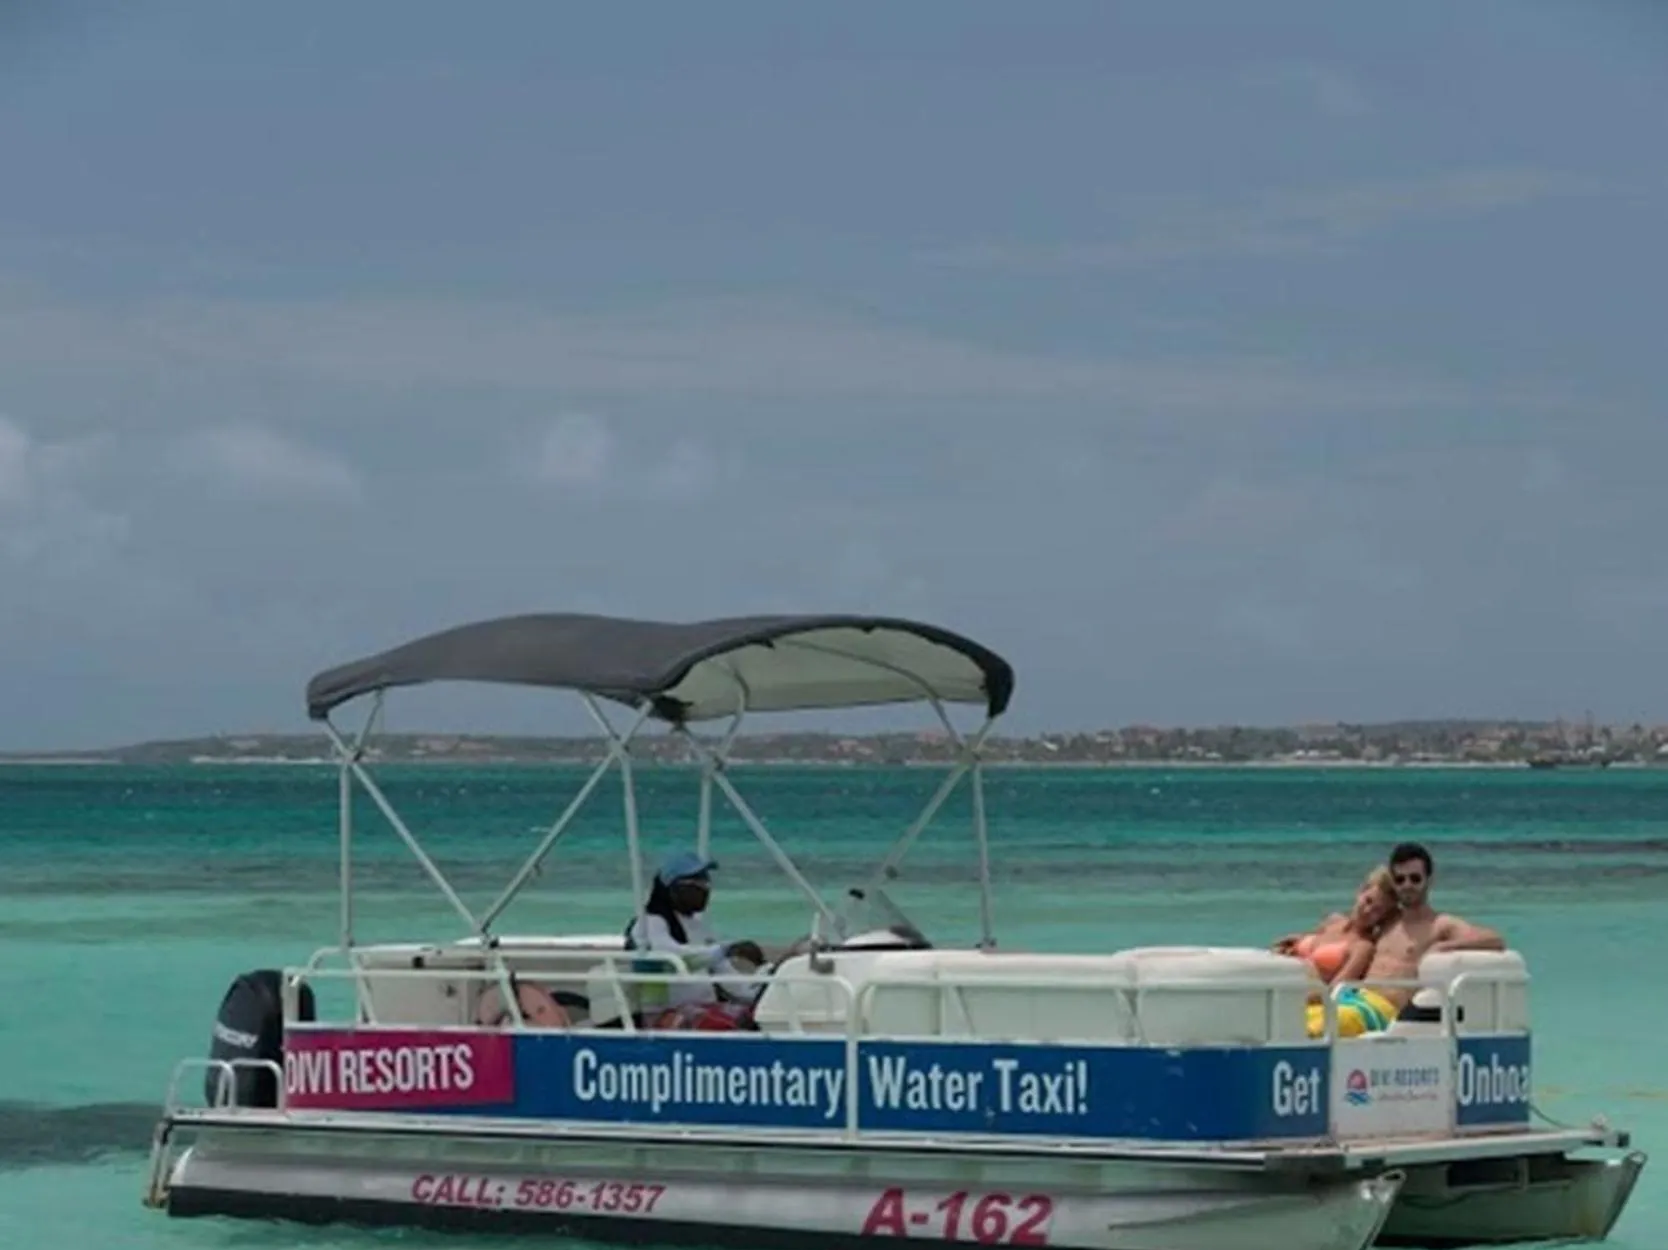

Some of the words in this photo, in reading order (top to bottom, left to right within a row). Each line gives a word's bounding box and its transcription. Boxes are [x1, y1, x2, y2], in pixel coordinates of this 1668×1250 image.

[339, 1044, 474, 1093] RESORTS
[573, 1049, 844, 1119] Complimentary
[868, 1055, 983, 1111] Water
[993, 1059, 1088, 1114] Taxi!
[1272, 1060, 1321, 1117] Get
[411, 1174, 505, 1206] CALL:
[514, 1178, 666, 1213] 586-1357
[861, 1187, 1054, 1246] A-162
